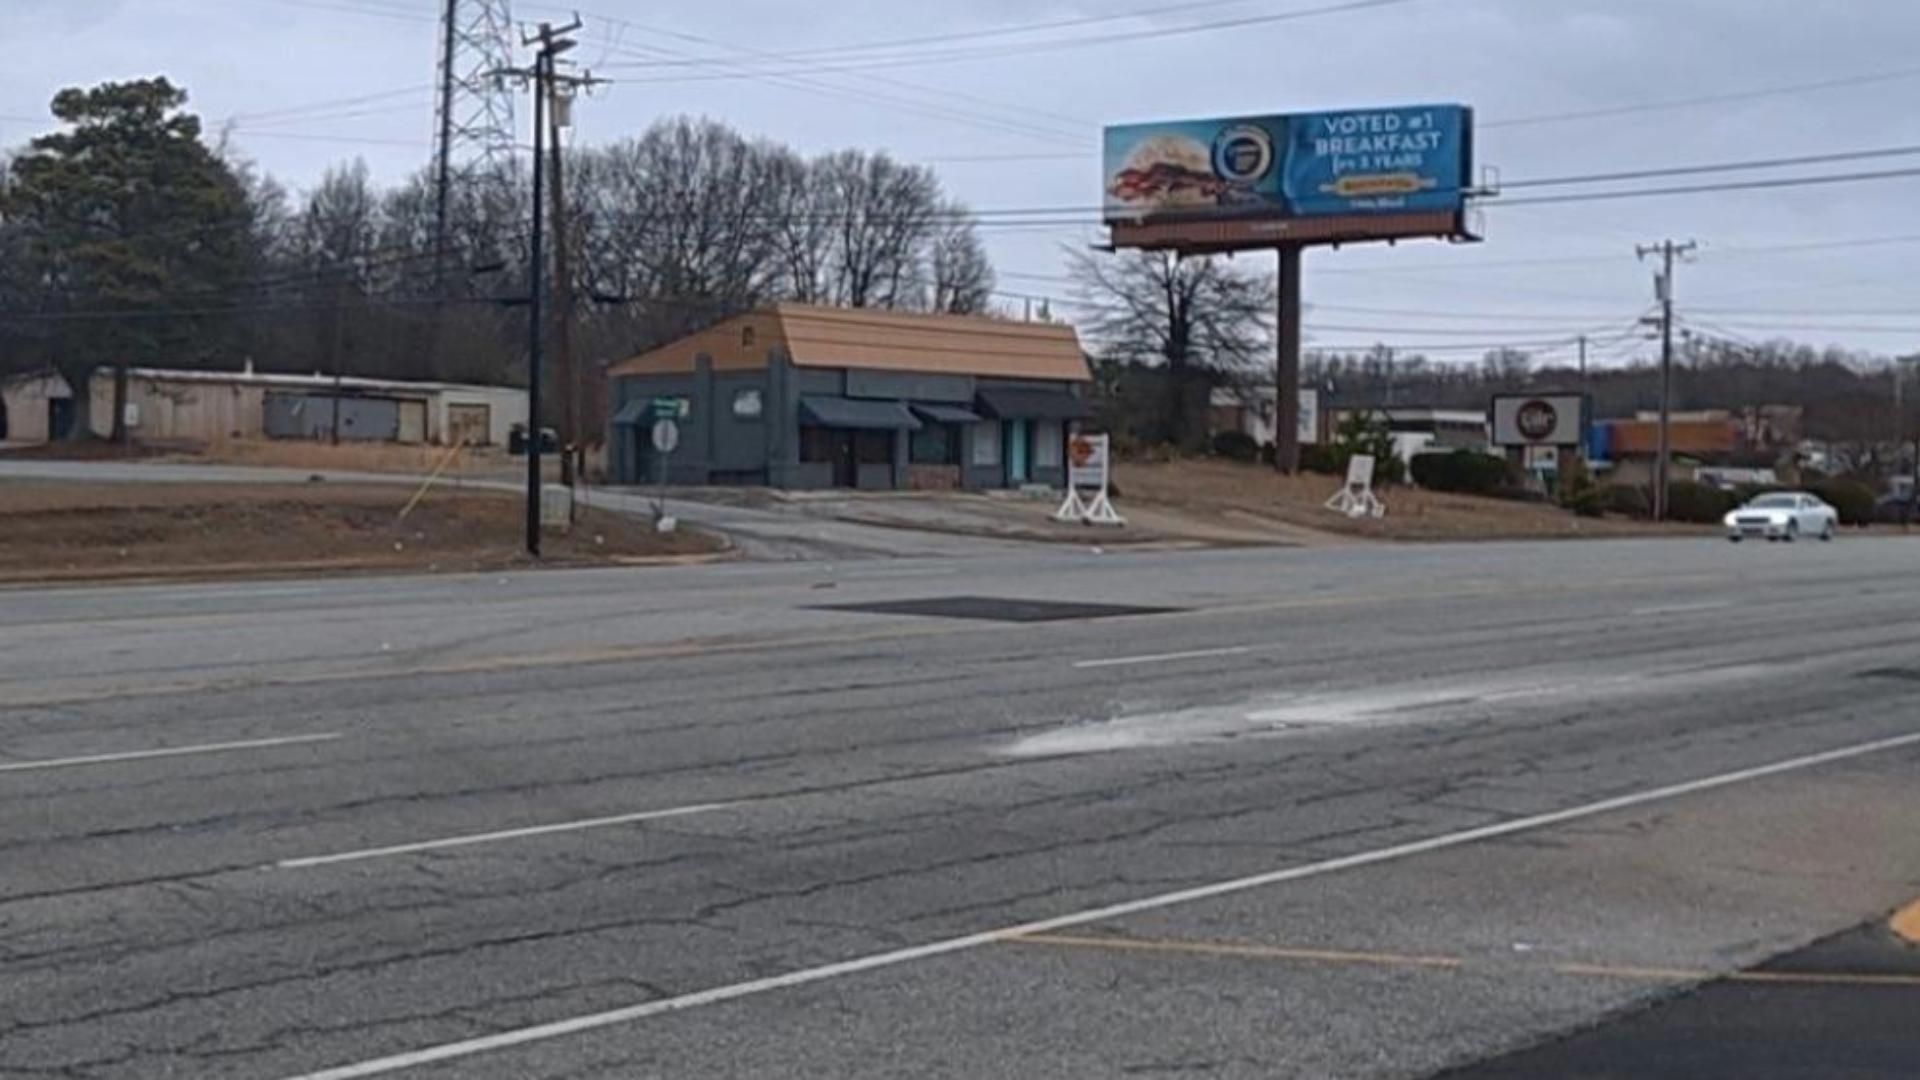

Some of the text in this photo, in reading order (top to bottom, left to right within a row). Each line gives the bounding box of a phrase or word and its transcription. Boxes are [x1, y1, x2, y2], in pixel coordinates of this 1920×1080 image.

[1324, 113, 1400, 134] VOTED
[1315, 131, 1442, 156] BREAKFAST
[1374, 152, 1423, 168] YEARS
